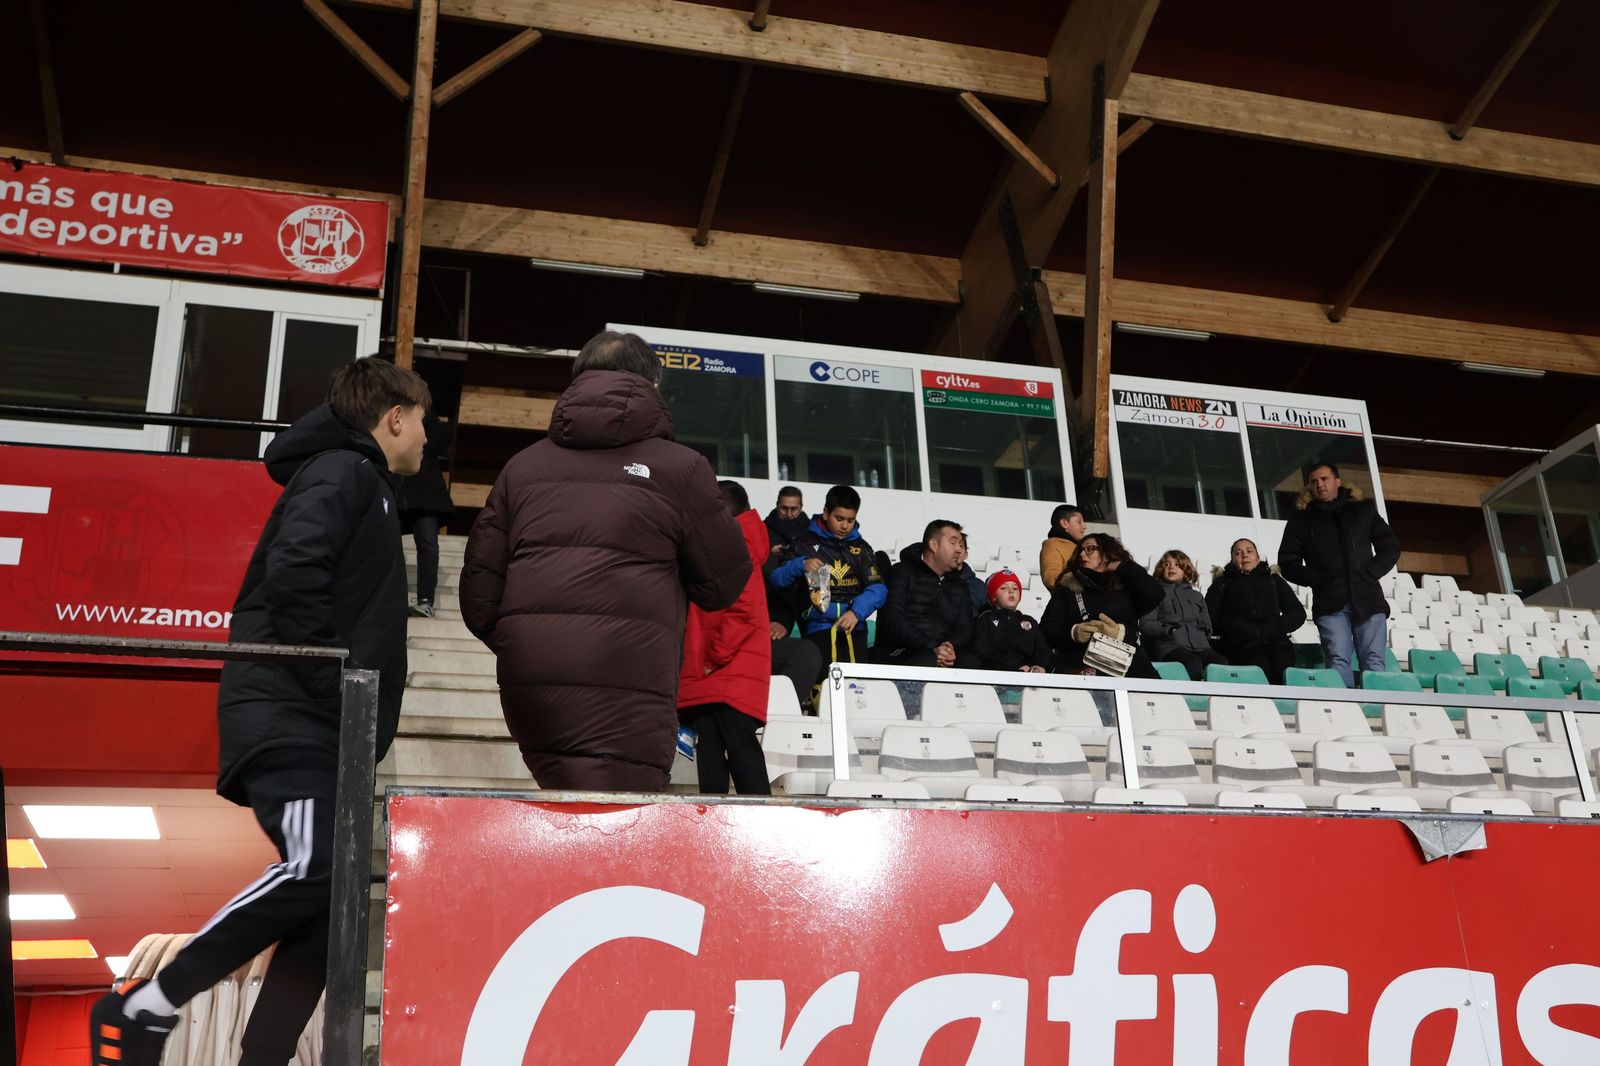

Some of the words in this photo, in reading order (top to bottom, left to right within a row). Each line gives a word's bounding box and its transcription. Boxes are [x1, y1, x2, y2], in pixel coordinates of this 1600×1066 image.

[0, 177, 76, 208] más
[90, 190, 174, 219] que
[704, 357, 724, 366] Radio
[704, 365, 737, 374] ZAMORA
[832, 366, 880, 384] COPE
[936, 374, 980, 389] cyltv.es
[948, 395, 969, 403] ONDA
[990, 400, 1019, 408] ZAMORA
[1119, 391, 1168, 409] ZAMORA
[1170, 397, 1203, 413] NEWS
[1204, 400, 1232, 416] ZN
[1130, 409, 1195, 427] Zamora
[1198, 415, 1225, 429] 3.0
[1260, 405, 1280, 422] La
[1285, 408, 1347, 429] Opinión
[55, 603, 233, 629] www.zamor
